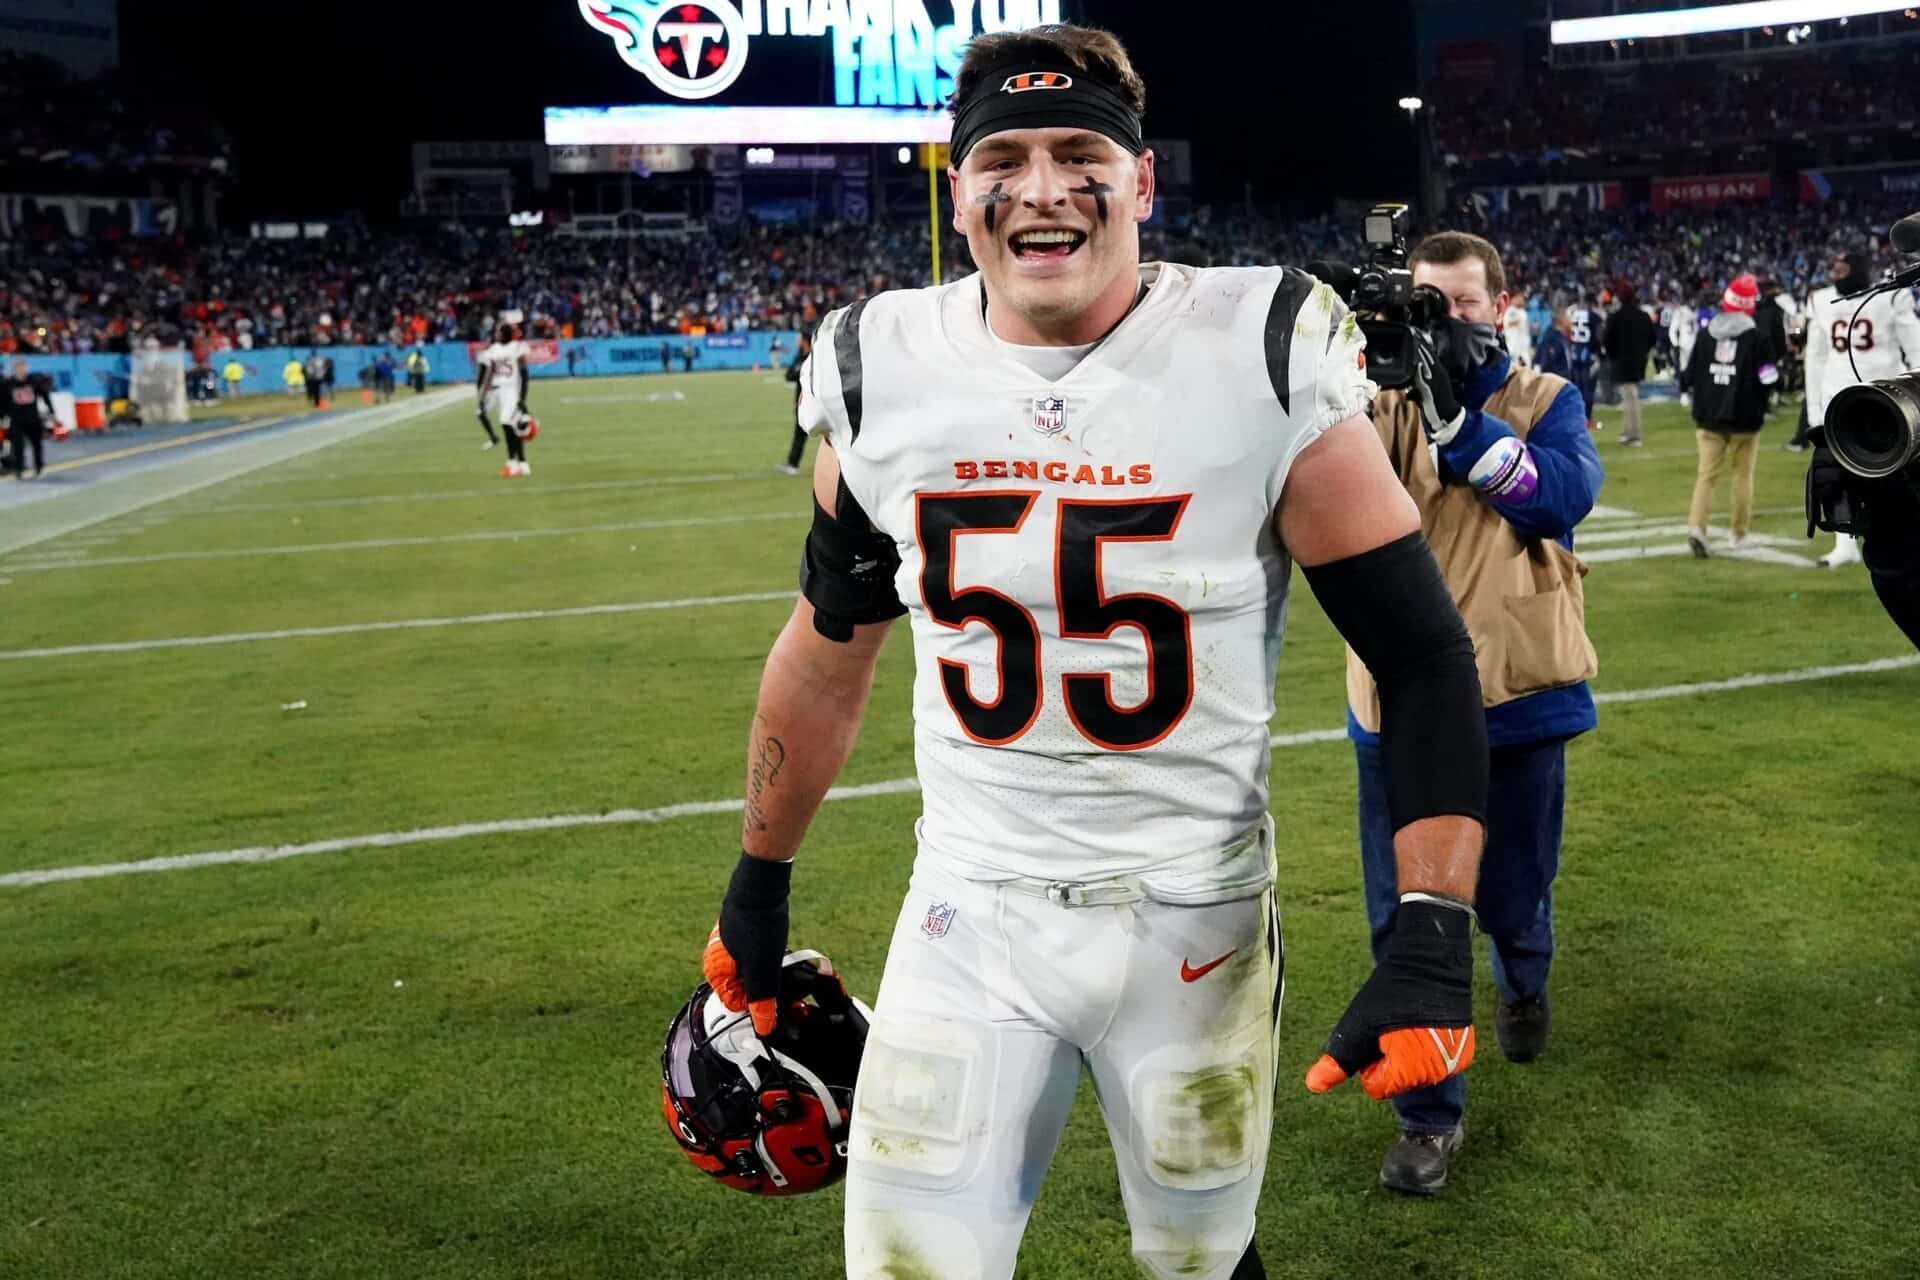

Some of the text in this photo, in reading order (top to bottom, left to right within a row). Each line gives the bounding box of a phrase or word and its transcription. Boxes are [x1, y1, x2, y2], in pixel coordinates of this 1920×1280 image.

[1664, 183, 1757, 200] NISSAN
[1831, 318, 1875, 353] 63
[1036, 411, 1061, 428] NFL
[953, 459, 1154, 486] BENGALS
[914, 488, 1194, 752] 55
